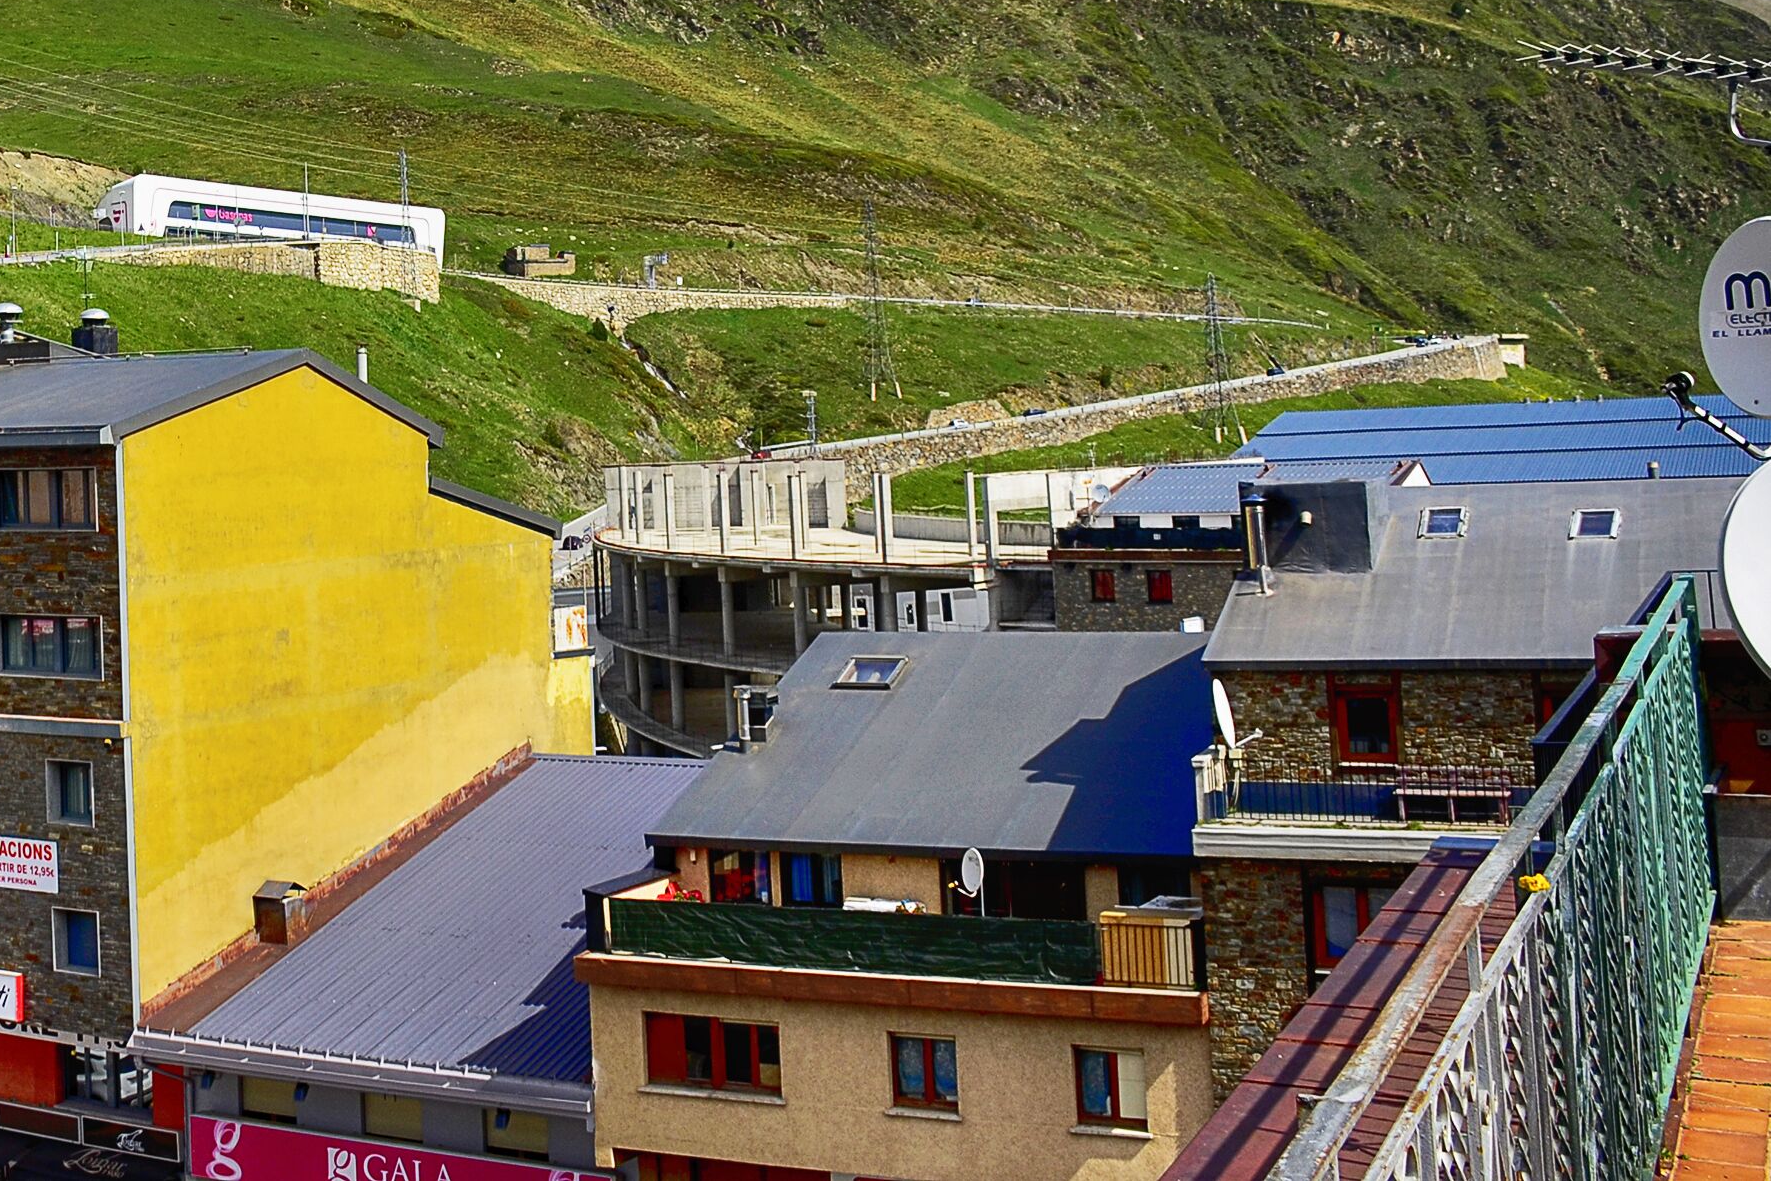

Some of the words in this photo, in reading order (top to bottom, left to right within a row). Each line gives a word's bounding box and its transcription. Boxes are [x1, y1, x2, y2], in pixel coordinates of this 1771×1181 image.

[1712, 330, 1729, 338] EL
[17, 864, 28, 875] DE
[29, 866, 55, 879] 12,95€
[7, 877, 38, 887] PERSONA
[362, 1153, 452, 1181] GALA
